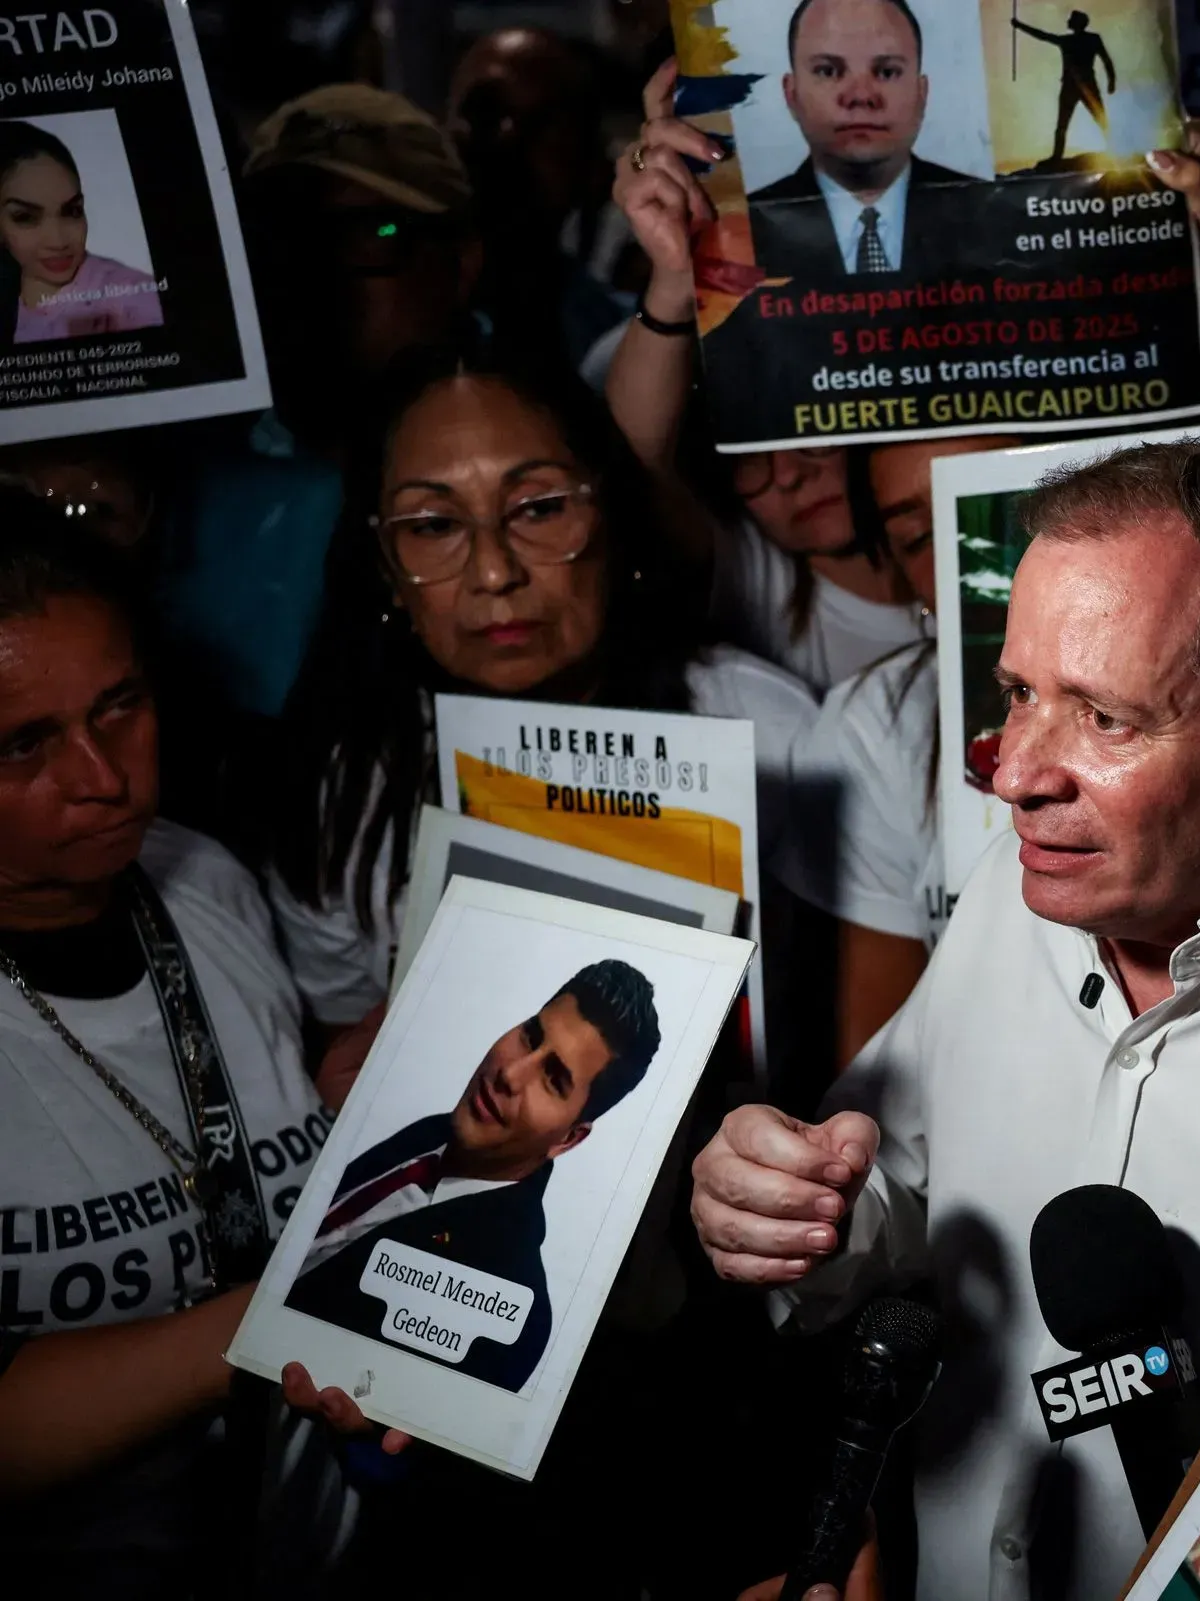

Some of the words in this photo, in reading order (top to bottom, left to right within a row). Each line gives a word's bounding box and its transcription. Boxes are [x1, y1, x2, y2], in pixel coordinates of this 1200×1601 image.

[21, 69, 95, 95] Mileidy
[101, 65, 174, 87] Johana
[1026, 195, 1105, 217] Estuvo
[1112, 189, 1176, 218] preso
[1016, 232, 1045, 251] en
[1051, 227, 1071, 249] el
[1078, 219, 1185, 248] Helicoide
[104, 276, 168, 297] libertad
[759, 292, 795, 318] En
[801, 279, 985, 318] desaparición
[993, 272, 1103, 304] forzada
[832, 329, 848, 356] 5
[856, 326, 894, 354] DE
[900, 318, 1020, 350] AGOSTO
[1028, 315, 1065, 343] DE
[1073, 309, 1141, 341] 2025
[67, 364, 86, 380] DE
[90, 352, 181, 377] TERRORISMO
[76, 374, 148, 394] NACIONAL
[812, 362, 893, 392] desde
[900, 366, 932, 386] su
[938, 347, 1127, 381] transferencia
[1134, 341, 1159, 368] al
[793, 397, 921, 434] FUERTE
[927, 377, 1171, 423] GUAICAIPURO
[519, 726, 635, 757] LIBEREN
[655, 736, 668, 759] A
[572, 753, 709, 793] PRESOS!
[547, 785, 661, 819] POLITICOS
[1, 1173, 188, 1254] LIBEREN
[0, 1248, 151, 1326] LOS
[373, 1252, 442, 1295] Rosmel
[440, 1276, 520, 1322] Mendez
[392, 1307, 462, 1351] Gedeon
[1042, 1353, 1155, 1424] SEIR
[1146, 1352, 1166, 1371] TV
